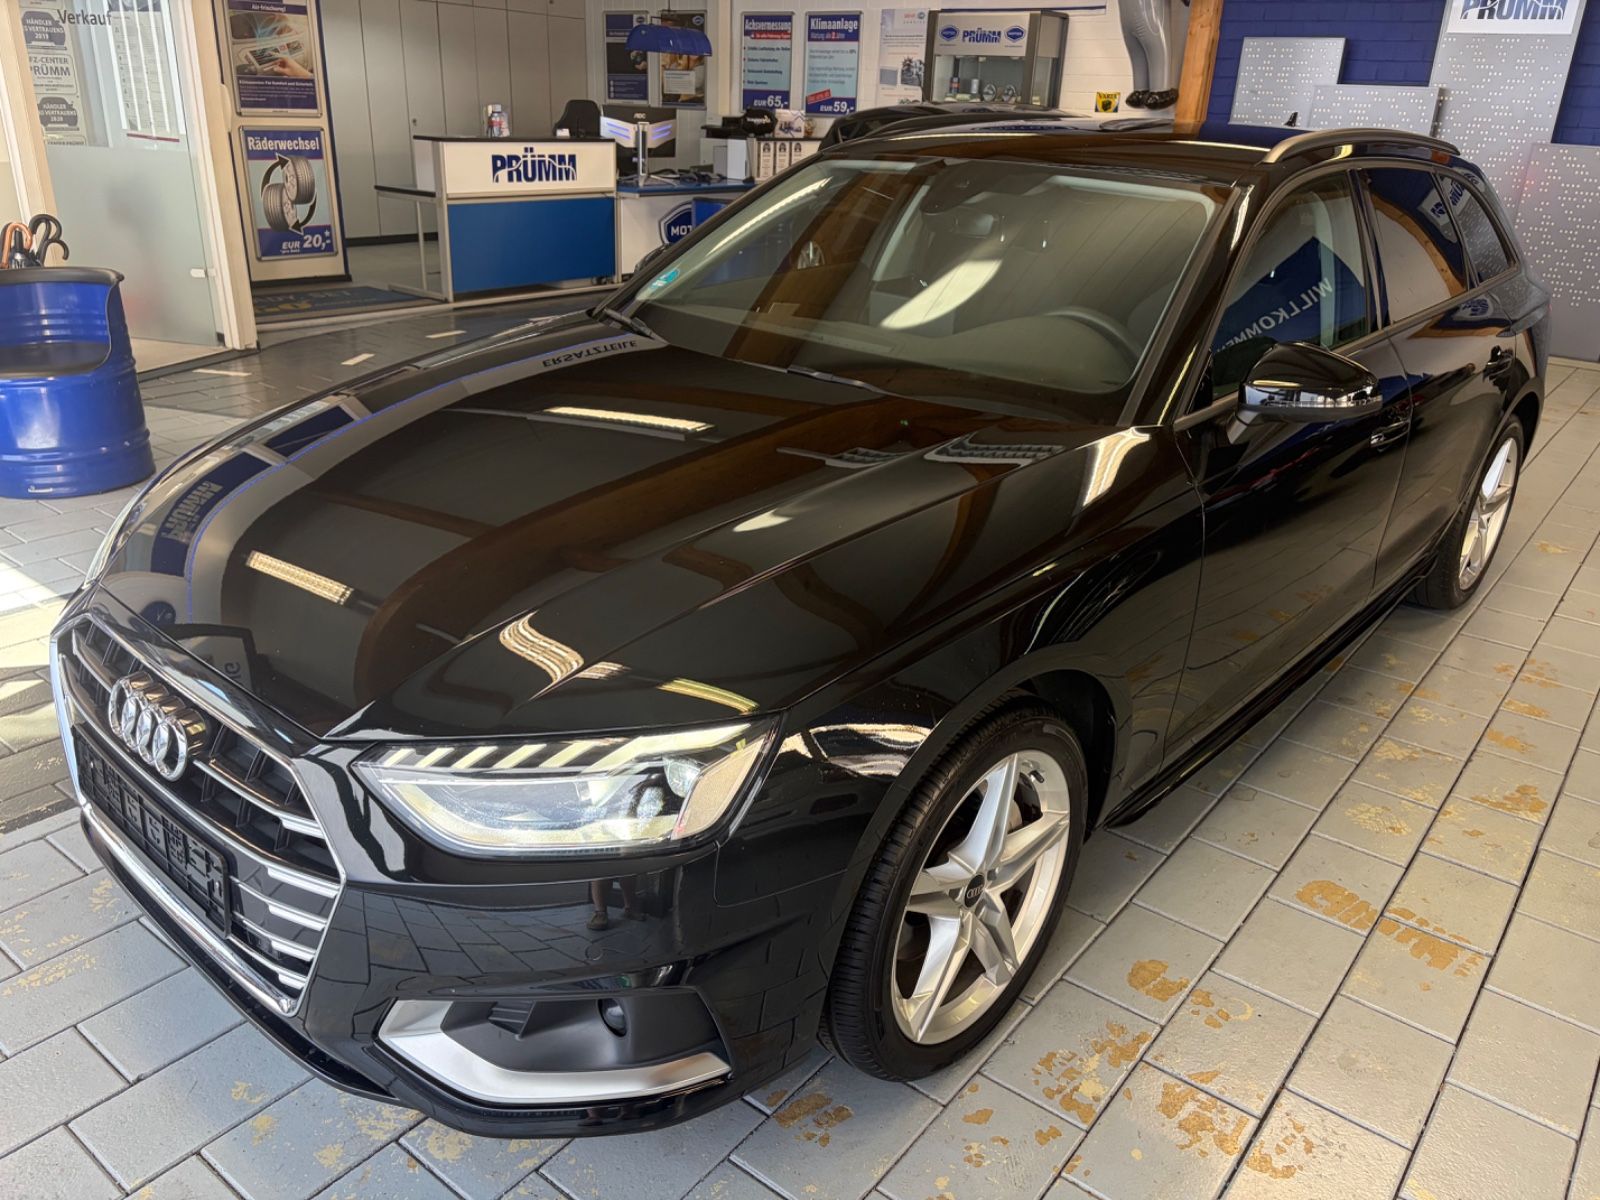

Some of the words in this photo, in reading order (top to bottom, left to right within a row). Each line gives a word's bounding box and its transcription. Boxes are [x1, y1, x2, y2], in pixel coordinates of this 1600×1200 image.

[57, 9, 112, 26] Verkauf
[811, 17, 858, 33] Klimaanlage
[745, 19, 792, 32] Achsvermessung
[962, 27, 1001, 43] PRÜMM
[30, 64, 70, 76] RÜMM
[767, 95, 788, 108] 65,-
[833, 101, 854, 114] 59,-
[247, 136, 320, 151] Räderwechsel
[491, 147, 577, 183] PRÜMM
[671, 225, 692, 236] MOT
[281, 241, 301, 250] EUR
[303, 234, 331, 250] 20,-
